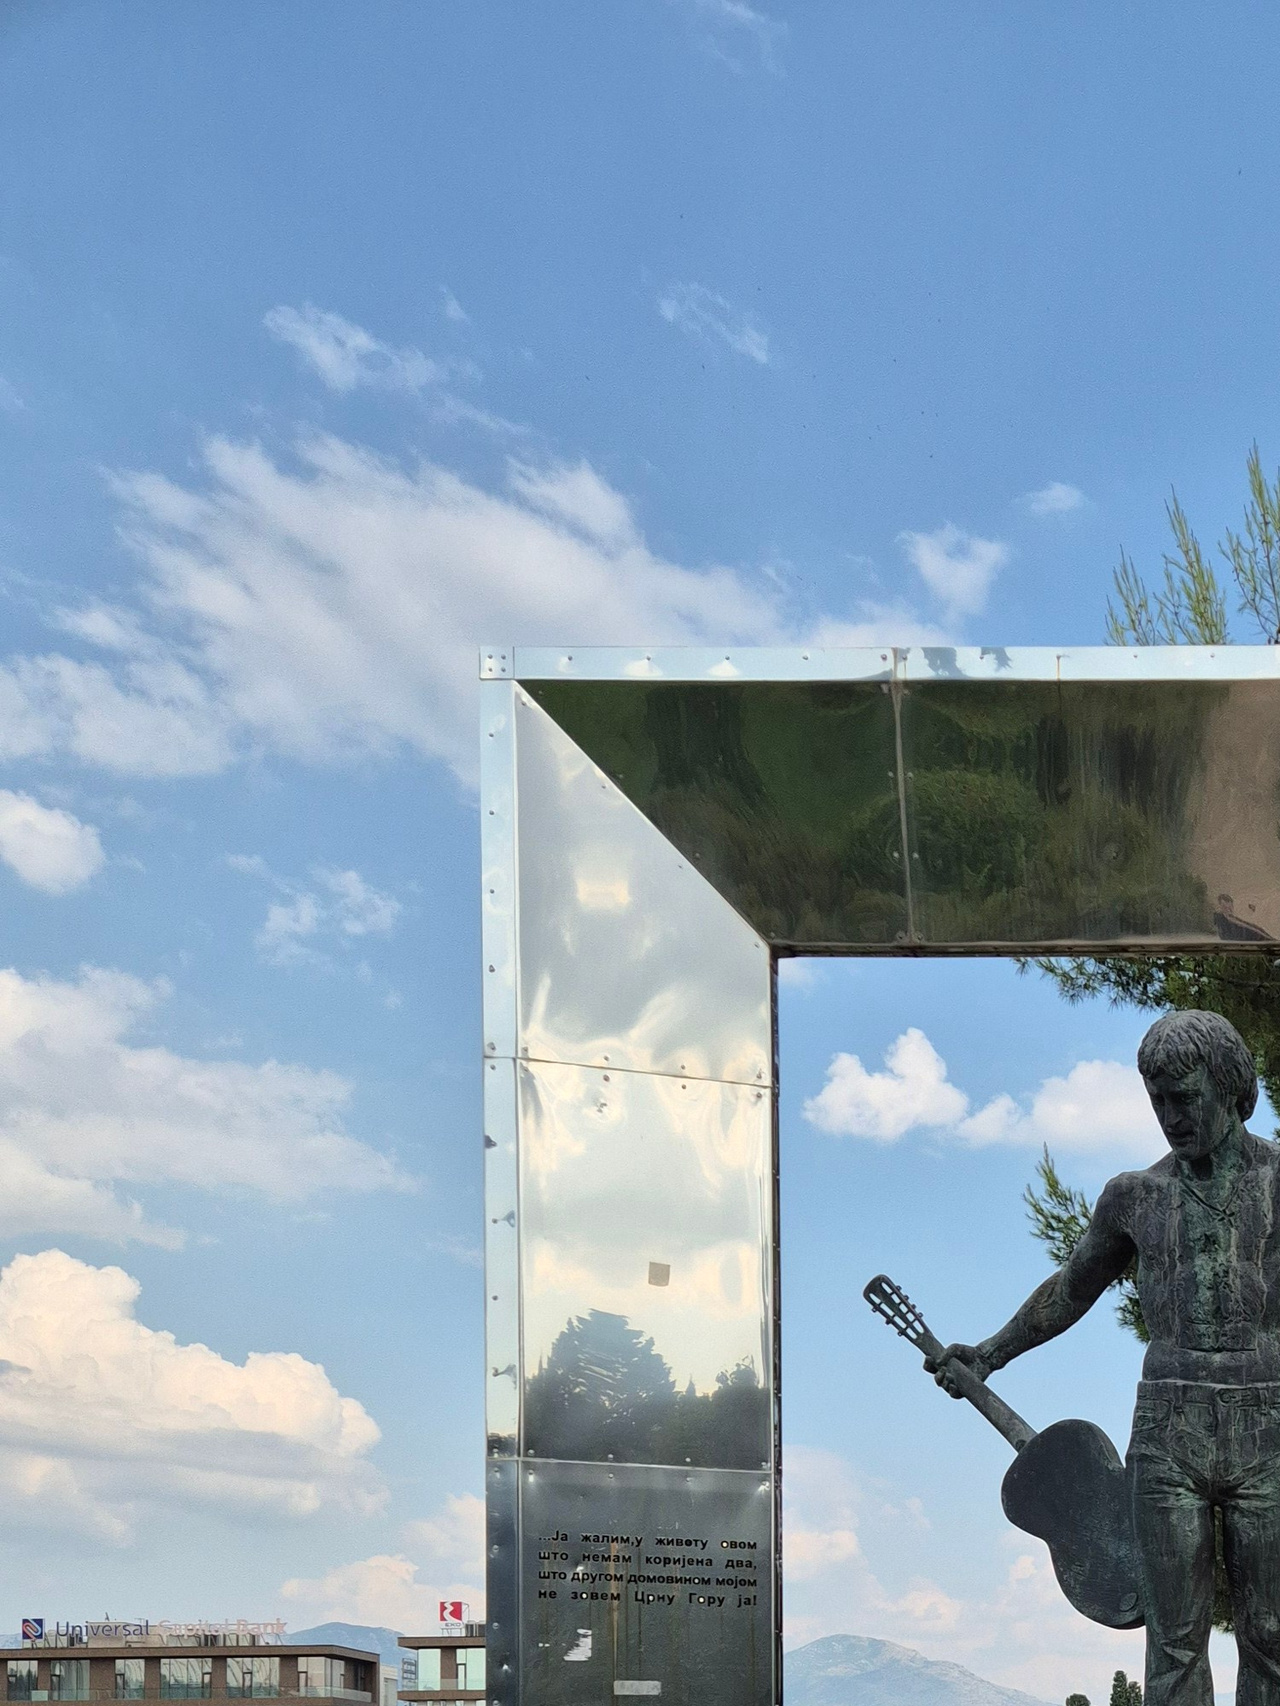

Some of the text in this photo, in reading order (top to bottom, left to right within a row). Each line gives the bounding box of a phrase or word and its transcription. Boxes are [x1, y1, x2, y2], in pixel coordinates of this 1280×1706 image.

[655, 1536, 708, 1549] животу
[720, 1540, 757, 1550] овом
[539, 1552, 757, 1569] што немам коријена два,
[539, 1570, 757, 1589] што другом домовином мојом
[539, 1590, 757, 1607] не зовем Црну Гору ја!
[56, 1618, 287, 1640] Universal Capital Bank
